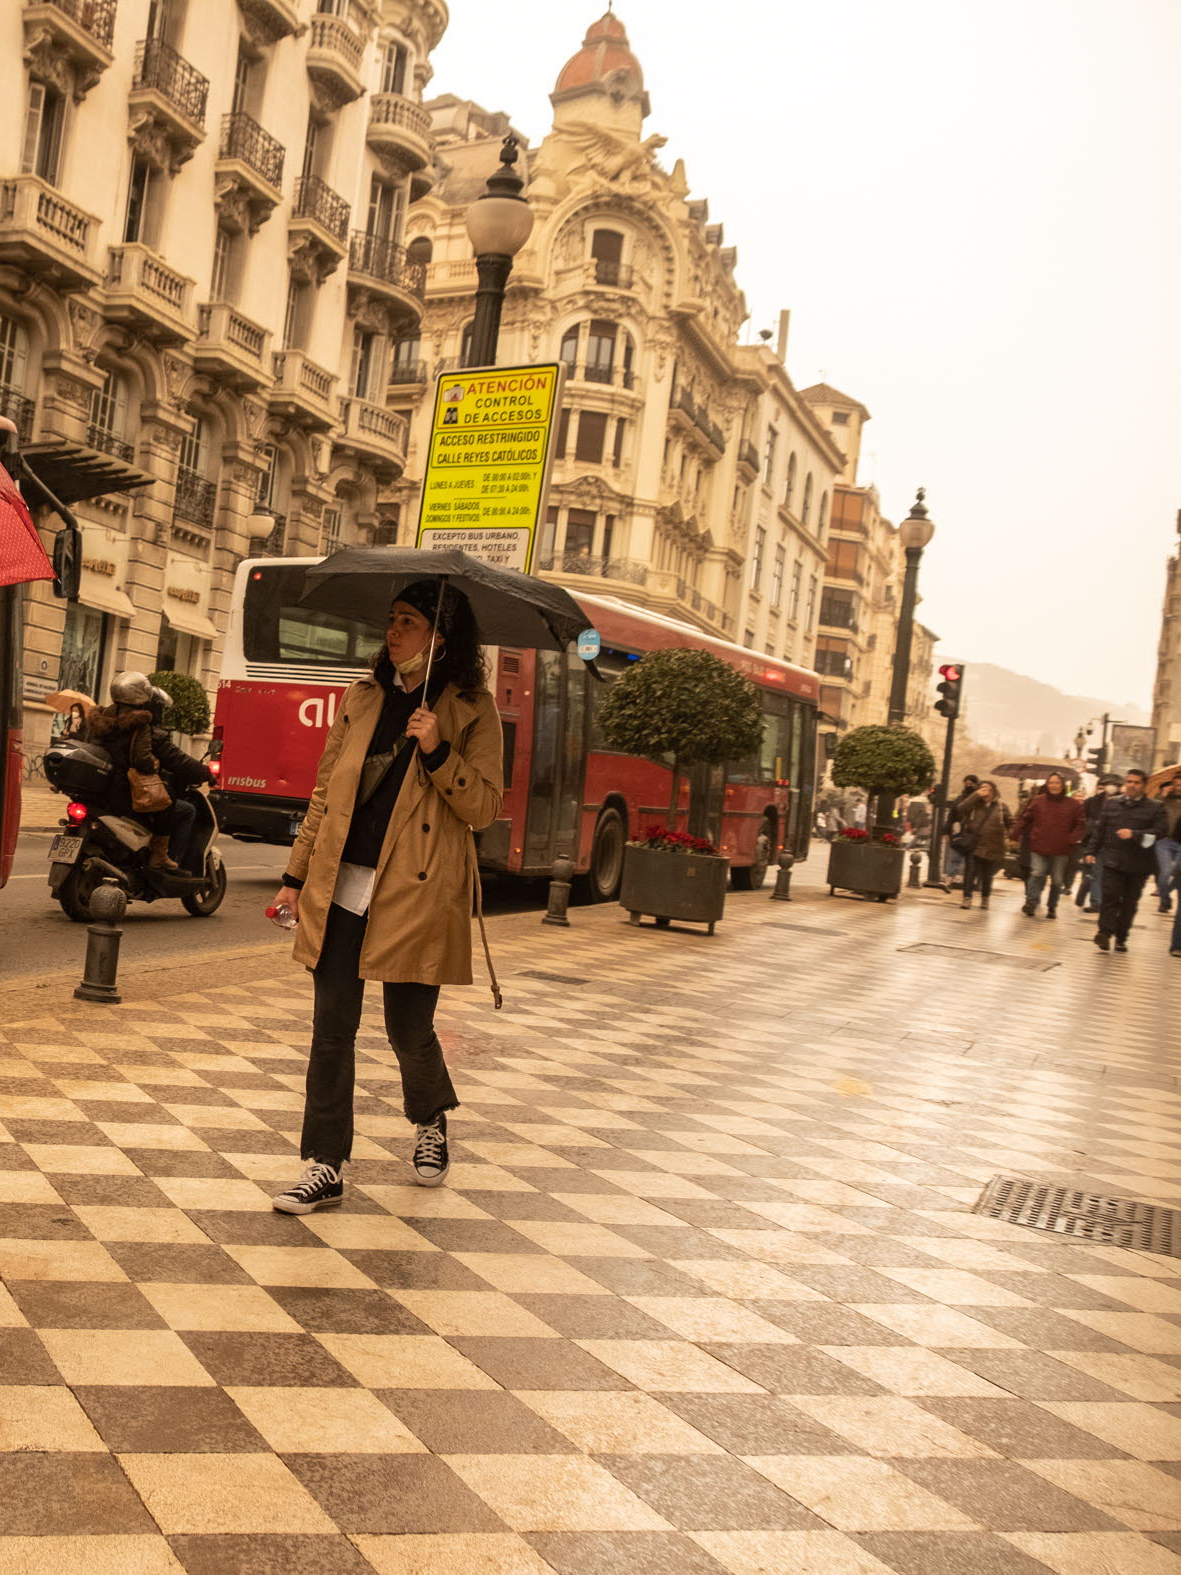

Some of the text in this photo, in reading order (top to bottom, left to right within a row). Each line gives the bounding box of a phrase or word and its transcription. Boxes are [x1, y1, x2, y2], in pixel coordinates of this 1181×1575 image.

[466, 374, 547, 395] ATENCIÓN
[475, 395, 534, 409] CONTROL
[464, 409, 542, 424] DE ACCESOS
[440, 430, 540, 446] ACCESO RESTRINGIDO
[437, 448, 538, 464] CALLE REYES CATÓLICOS
[483, 472, 491, 481] DE
[533, 471, 539, 480] Y
[429, 480, 475, 490] LUNES A JUEVES
[481, 484, 490, 493] DE
[482, 507, 491, 516] DE
[432, 531, 520, 541] EXCEPTO BUS URBANO,
[481, 543, 517, 552] HOTELES
[487, 555, 504, 563] TAXI
[227, 776, 268, 789] irisbus
